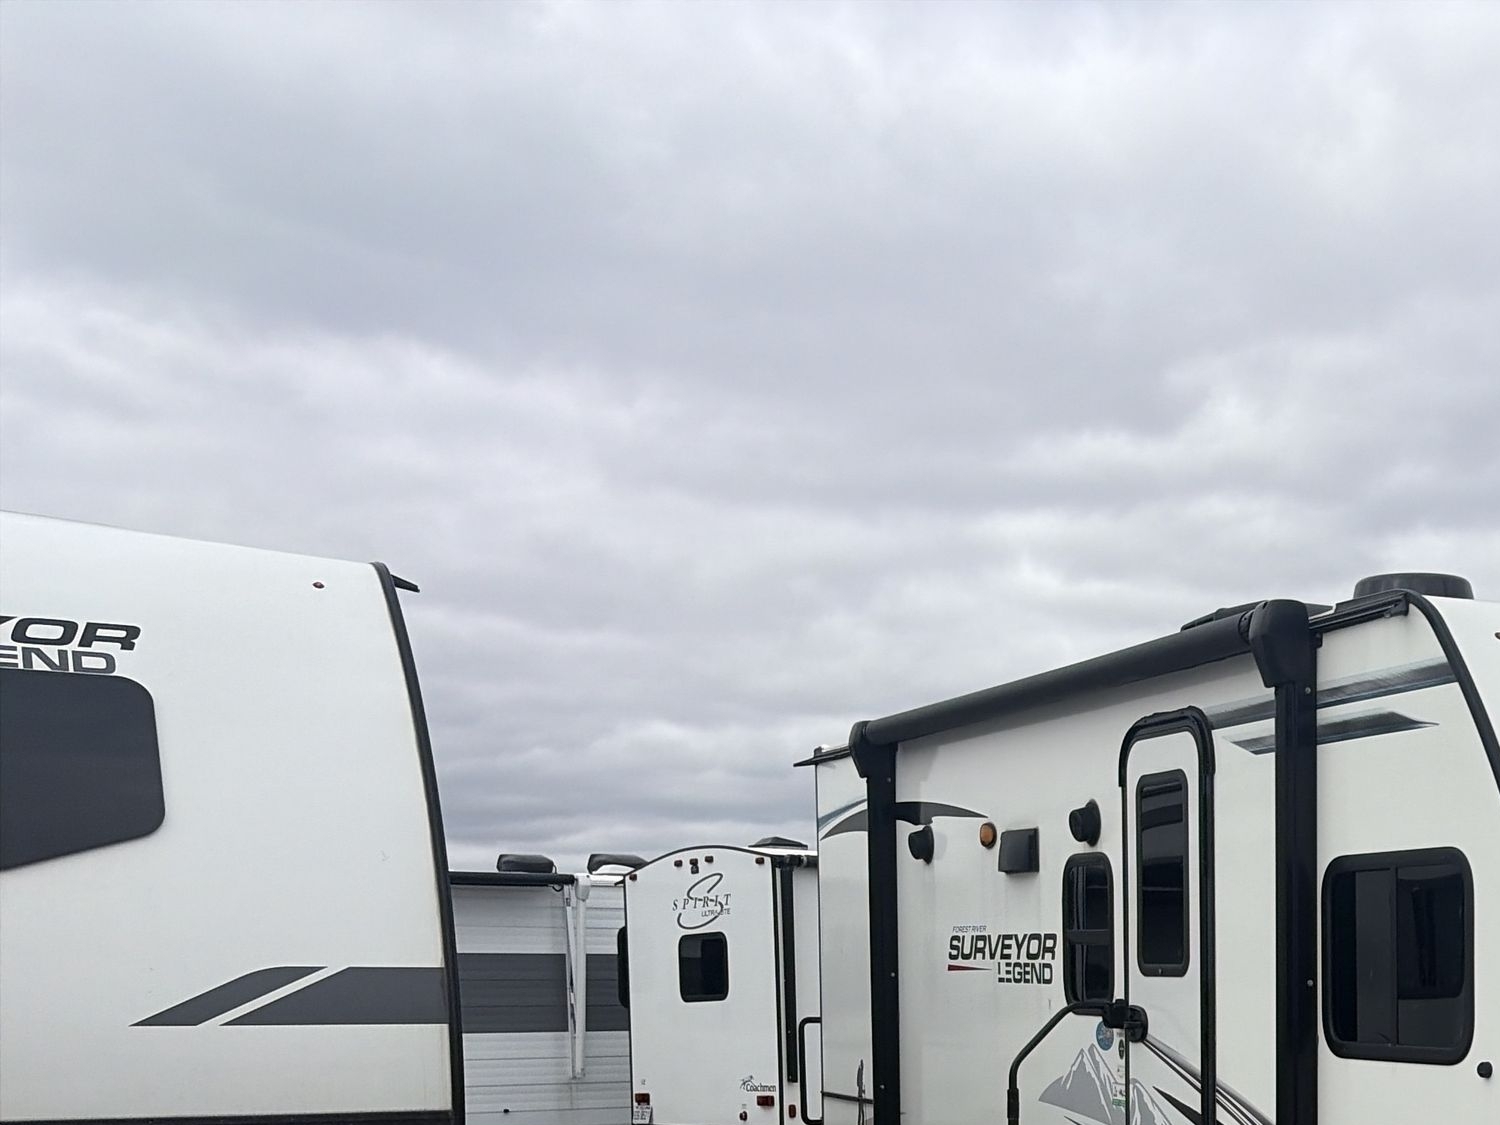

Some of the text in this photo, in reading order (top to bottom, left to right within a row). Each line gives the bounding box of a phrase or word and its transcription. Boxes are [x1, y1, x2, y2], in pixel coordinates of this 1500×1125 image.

[0, 615, 141, 651] OR
[672, 893, 731, 911] SPIRIT
[948, 933, 1058, 960] SURVEYOR
[998, 962, 1053, 984] LEGEND
[746, 1083, 776, 1092] Coachmen
